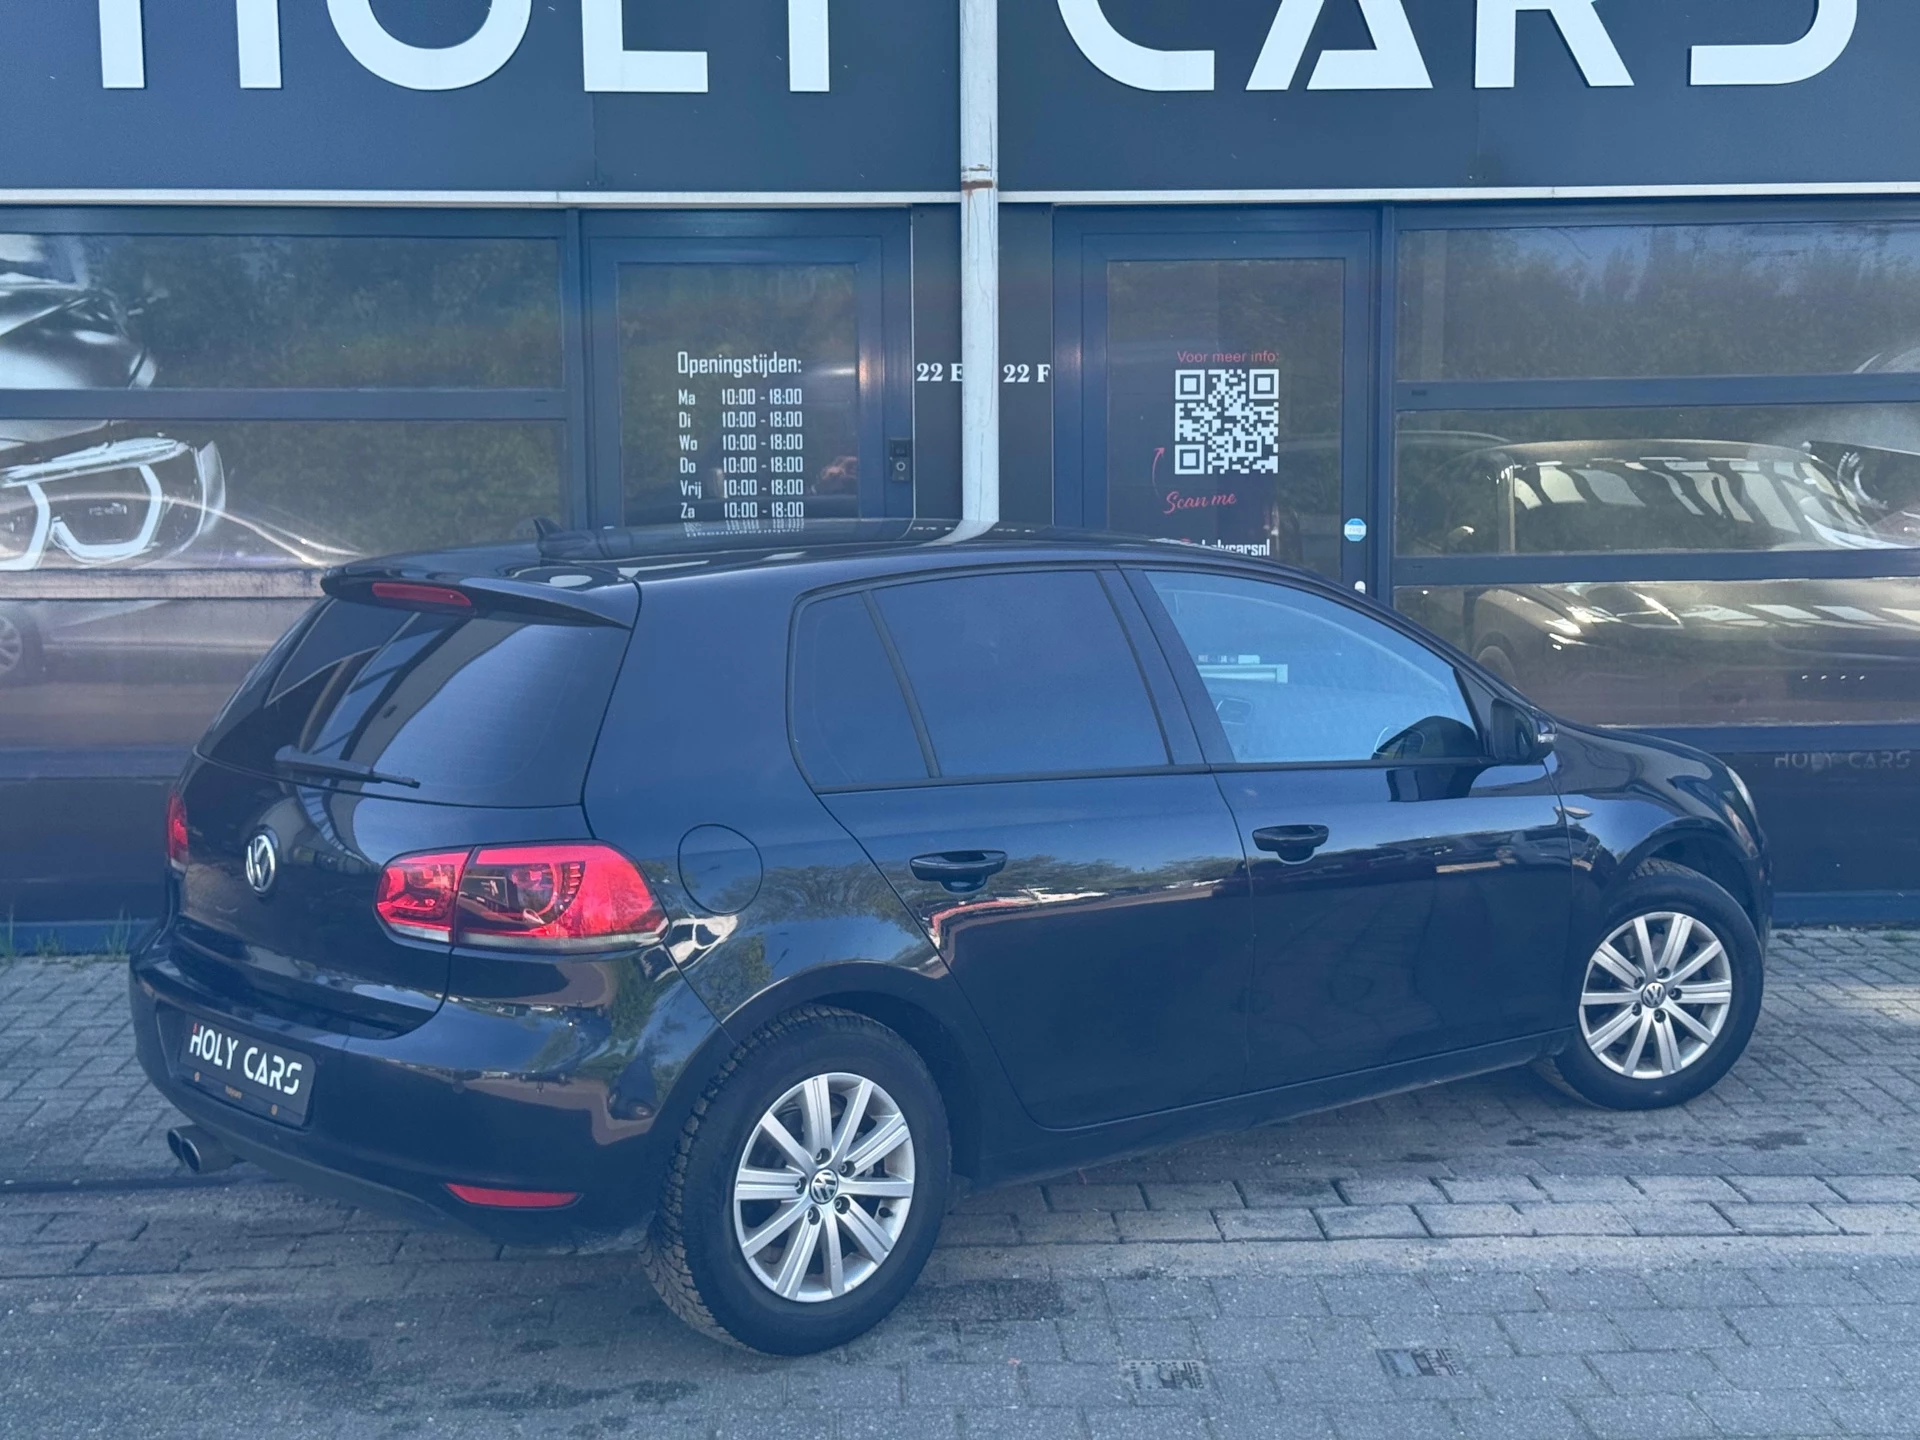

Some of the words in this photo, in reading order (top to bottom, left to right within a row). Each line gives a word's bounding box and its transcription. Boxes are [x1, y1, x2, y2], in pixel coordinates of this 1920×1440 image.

[677, 351, 802, 378] Openingstijden:
[1177, 350, 1208, 363] Voor
[1212, 352, 1247, 363] meer
[1251, 350, 1280, 363] info:
[916, 363, 943, 382] 22
[950, 363, 963, 382] E
[1003, 364, 1030, 383] 22
[1036, 364, 1051, 383] F
[678, 389, 696, 405] Ma
[722, 388, 756, 405] 10:00
[769, 388, 802, 405] 18:00
[678, 411, 691, 428] Di
[722, 411, 756, 428] 10:00
[769, 411, 803, 428] 18:00
[679, 434, 698, 450] Wo
[722, 434, 757, 450] 10:00
[770, 434, 803, 450] 18:00
[680, 457, 696, 473] Do
[723, 456, 757, 473] 10:00
[770, 456, 803, 473] 18:00
[680, 480, 702, 499] Vrij
[724, 479, 757, 496] 10:00
[771, 479, 804, 496] 18:00
[681, 502, 695, 519] Za
[724, 502, 758, 518] 10:00
[771, 502, 804, 518] 18:00
[1163, 491, 1208, 514] Scan
[1211, 493, 1237, 506] me
[1774, 753, 1834, 769] HOLY
[1848, 750, 1911, 769] CARS
[189, 1022, 239, 1070] HOLY
[243, 1047, 302, 1095] CARS
